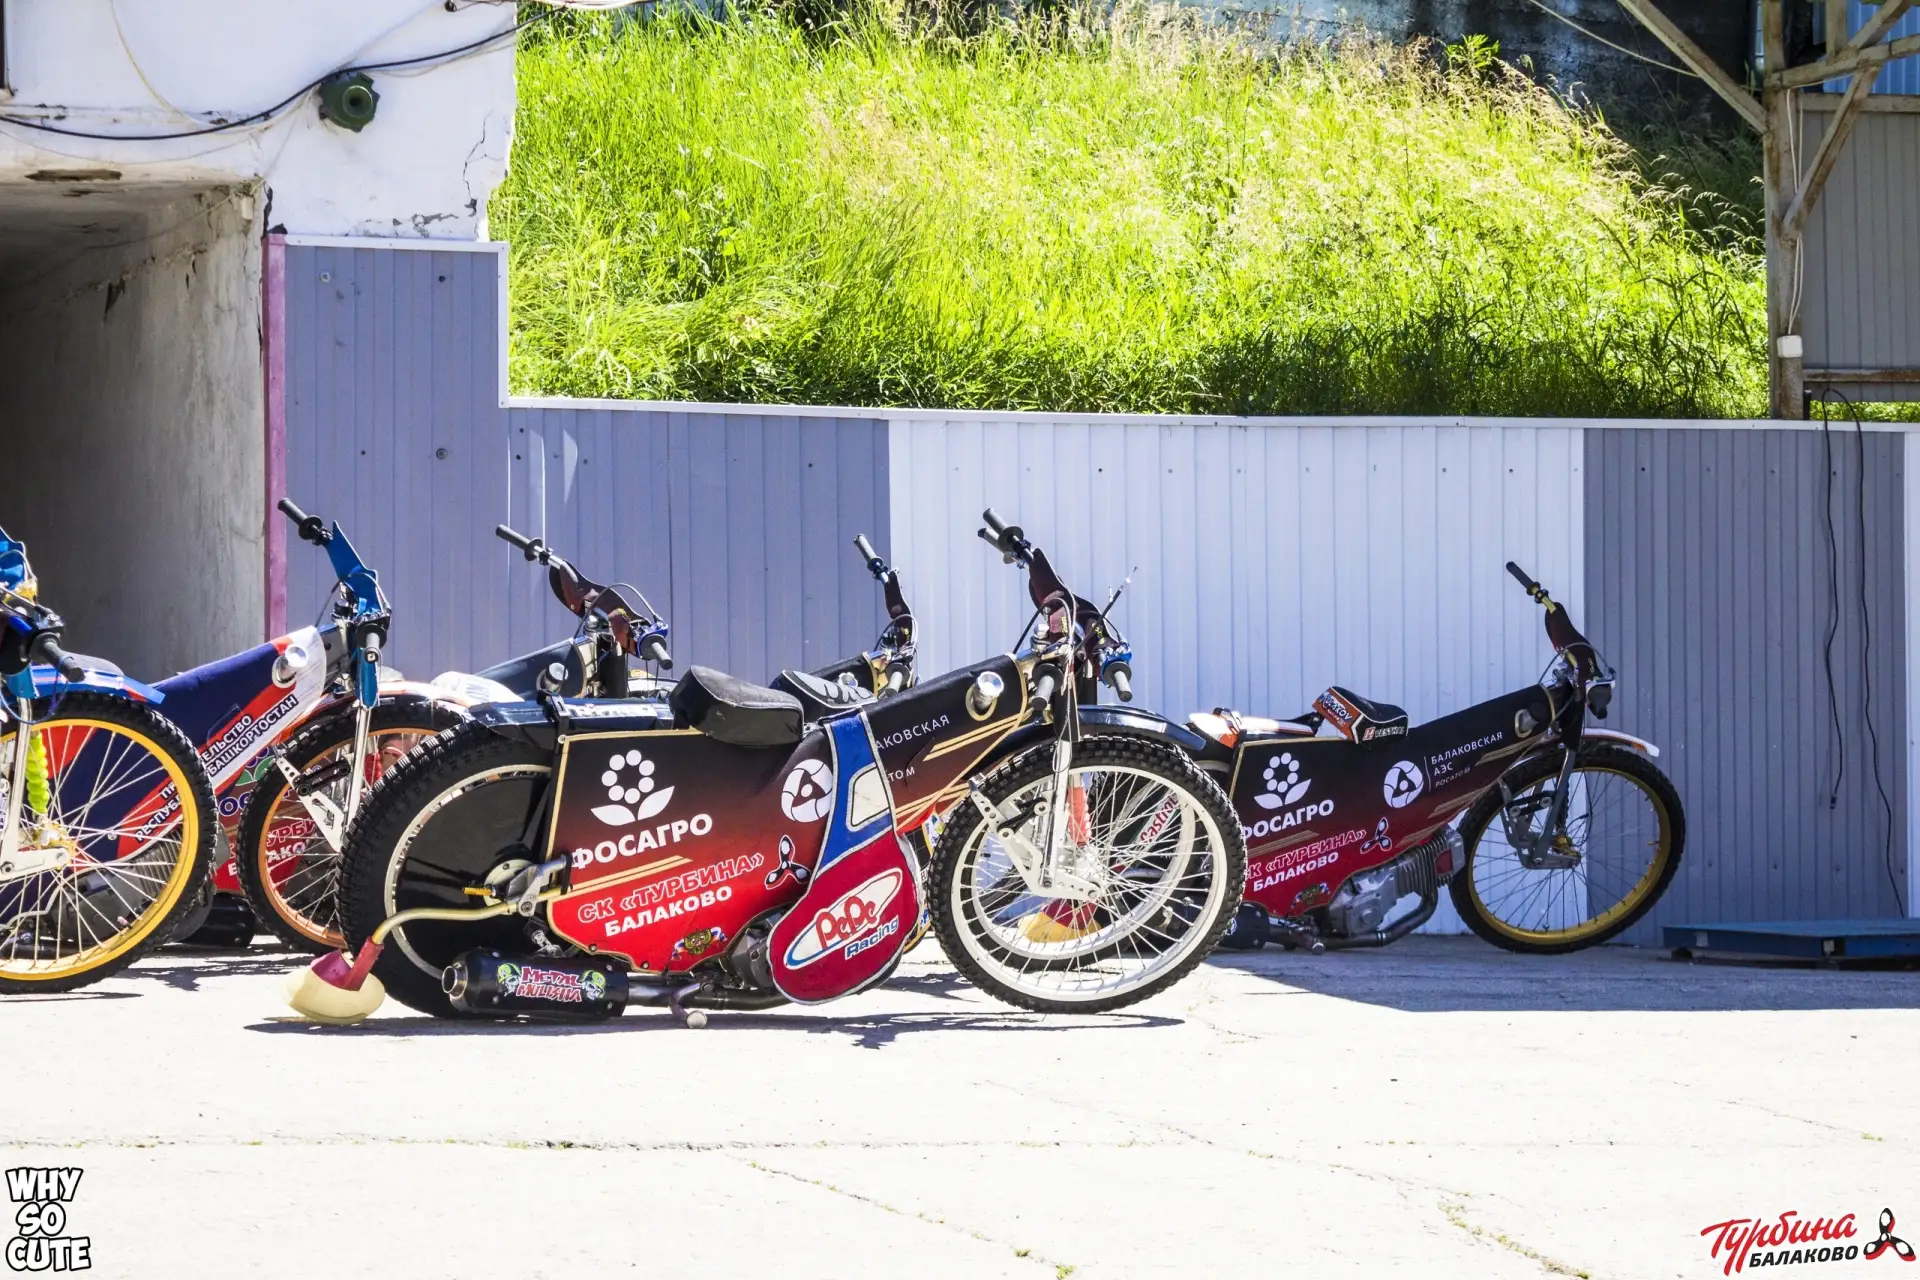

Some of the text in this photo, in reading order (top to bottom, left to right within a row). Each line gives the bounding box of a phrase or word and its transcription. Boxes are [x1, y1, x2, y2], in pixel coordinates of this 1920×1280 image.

[201, 715, 252, 762] ЕЛЬСТВО
[206, 694, 299, 777] БАШКОРТОСТАН
[876, 715, 950, 749] АКОВСКАЯ
[1431, 731, 1503, 765] БАЛАКОВСКАЯ
[888, 766, 915, 781] ТОМ
[1434, 761, 1453, 777] АЭС
[1435, 767, 1471, 787] РОСАТОМ
[573, 813, 713, 869] ФОСАГРО
[1245, 829, 1367, 879] К «ТУРБИНА»
[578, 852, 764, 924] СК «ТУРБИНА»
[1253, 851, 1339, 892] БАЛАКОВО
[604, 886, 732, 937] БАЛАКОВО
[844, 914, 899, 960] Racing
